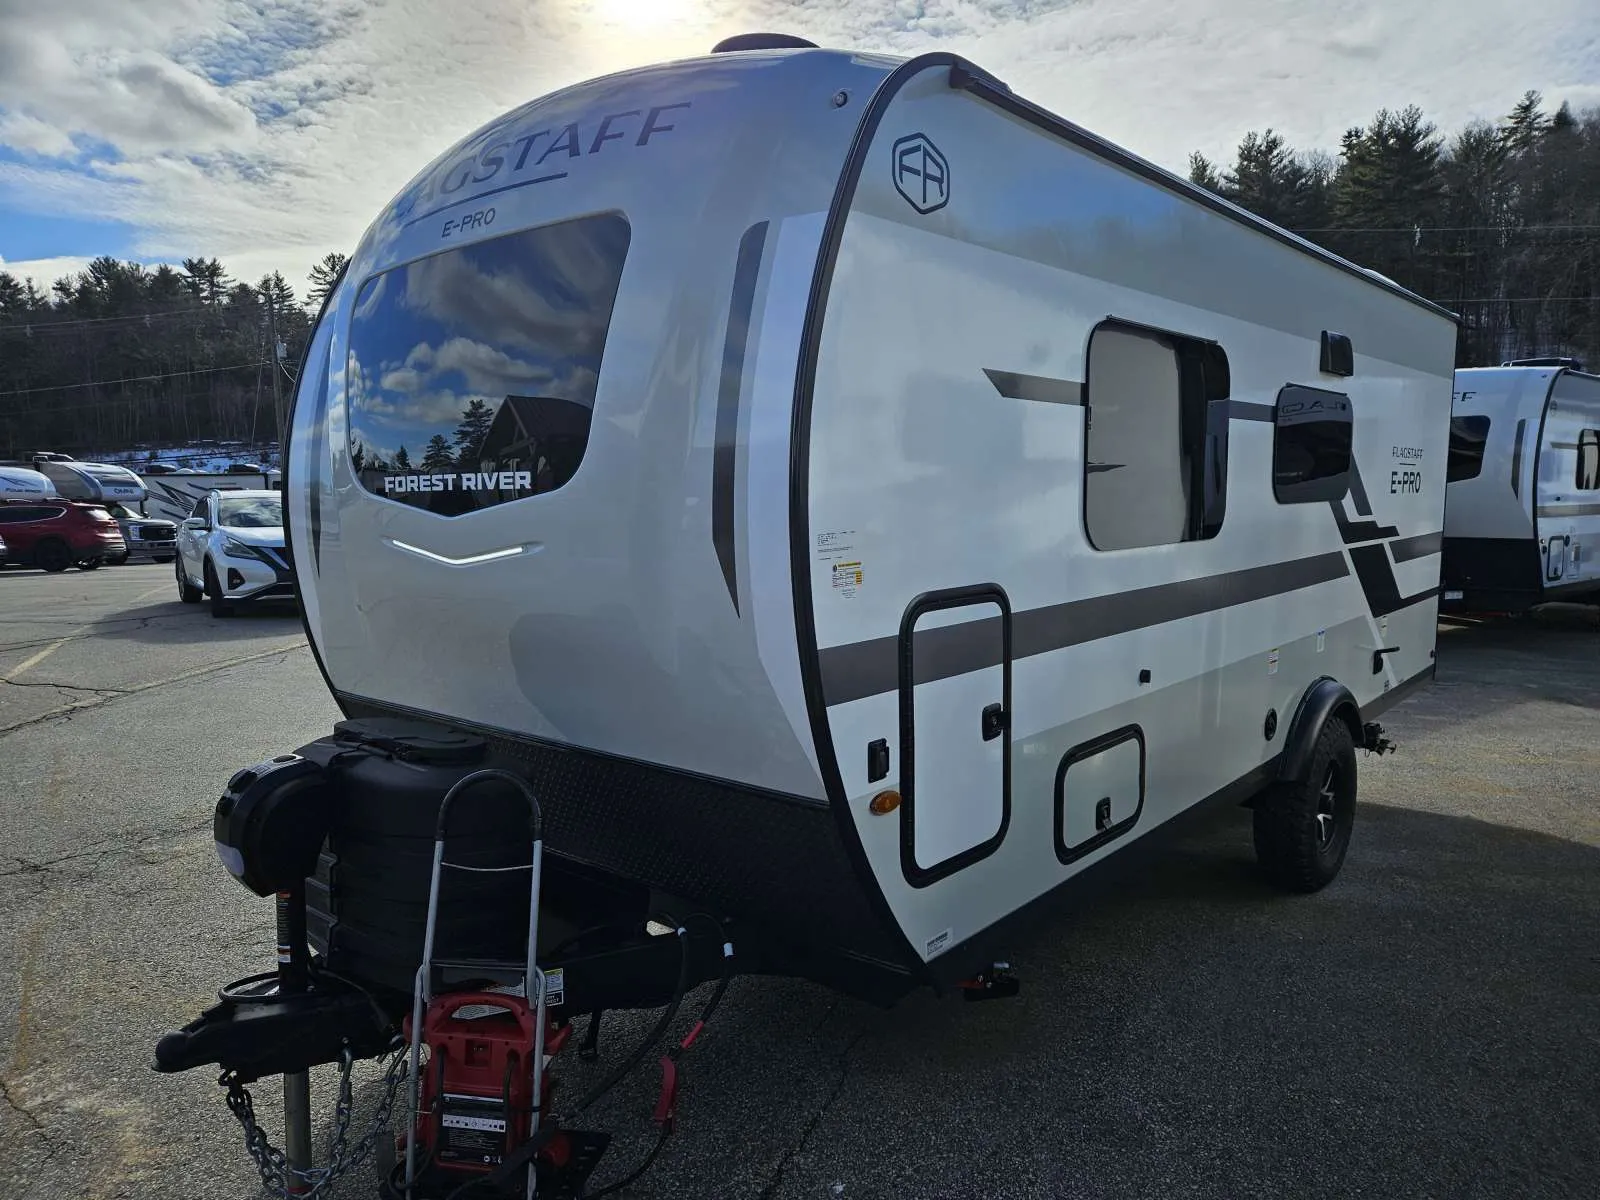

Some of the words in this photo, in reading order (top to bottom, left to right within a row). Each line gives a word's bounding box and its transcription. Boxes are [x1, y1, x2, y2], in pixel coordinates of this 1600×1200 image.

[441, 207, 496, 238] E-PRO
[1392, 446, 1423, 460] FLAGSTAFF
[384, 474, 457, 493] FOREST
[461, 471, 532, 490] RIVER
[1390, 471, 1421, 494] E-PRO
